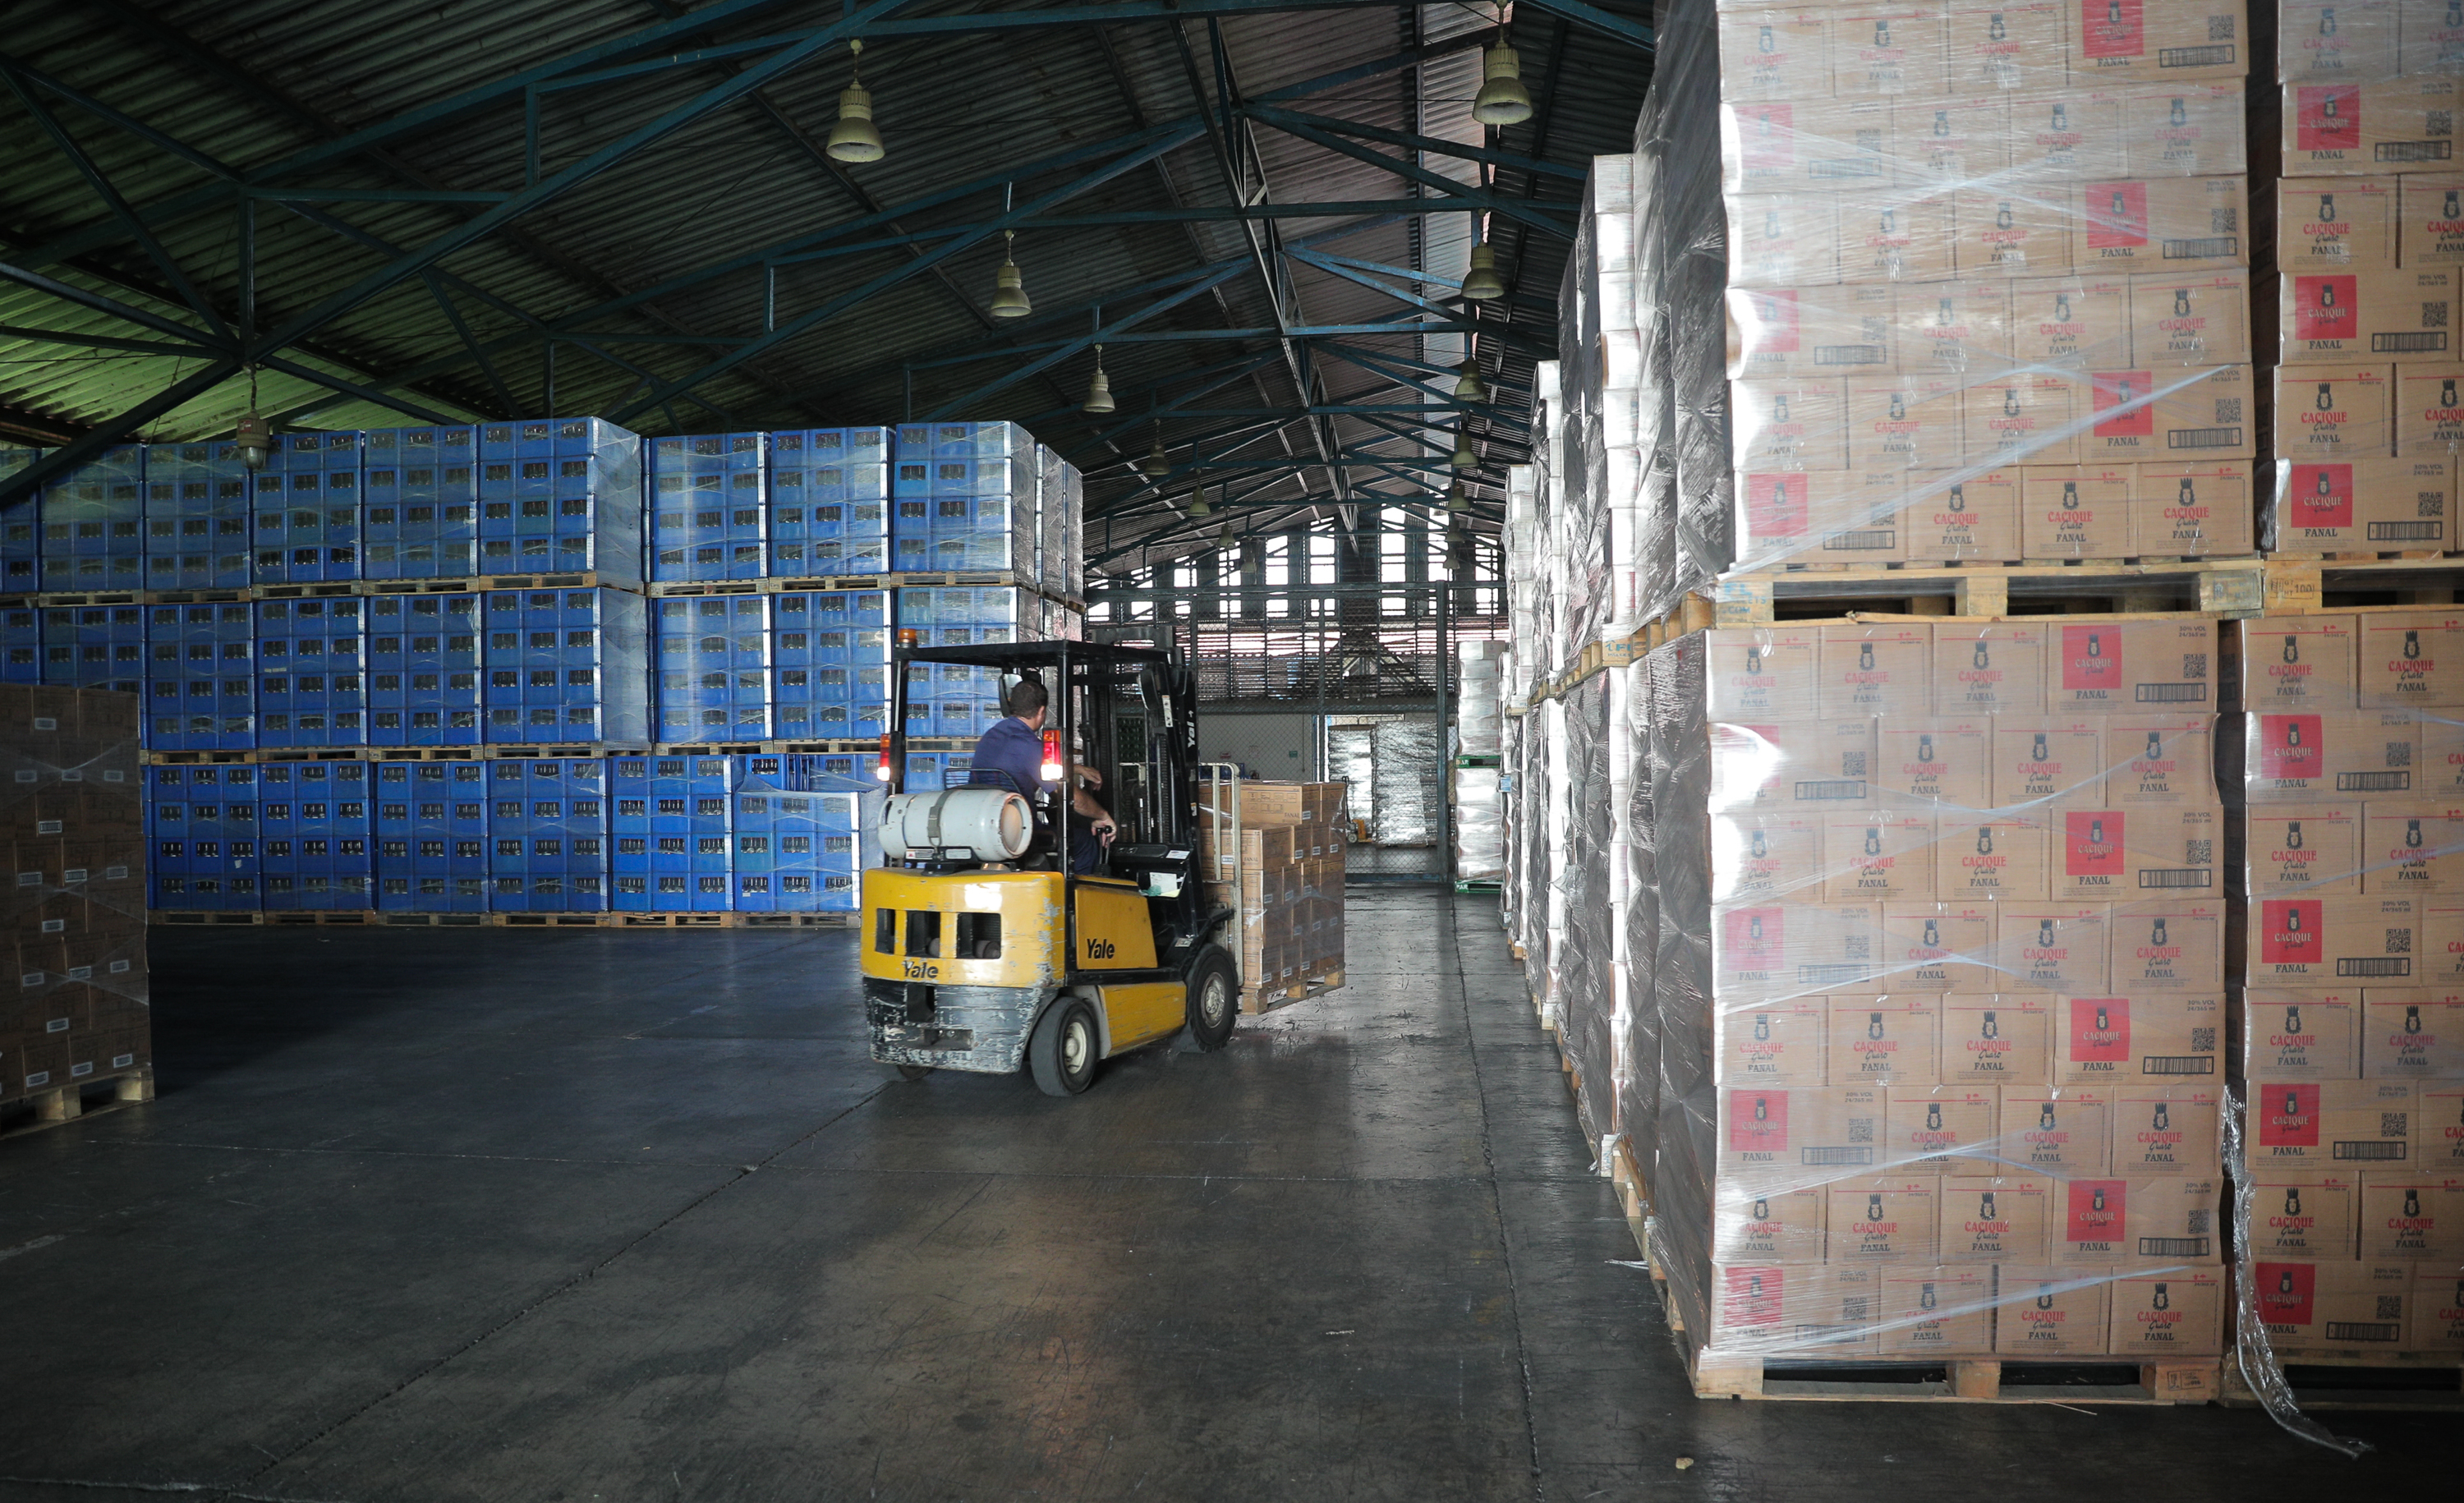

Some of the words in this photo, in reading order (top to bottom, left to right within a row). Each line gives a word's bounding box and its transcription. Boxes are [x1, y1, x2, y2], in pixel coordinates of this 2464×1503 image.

[2097, 57, 2130, 67] FANAL
[2311, 150, 2344, 160] FANAL
[2303, 223, 2350, 237] CACIQUE
[2427, 221, 2464, 235] CACIQU
[2102, 248, 2133, 257] FANAL
[2307, 308, 2347, 319] CACIQUE
[2159, 318, 2206, 332] CACIQUE
[2309, 340, 2342, 350] FANAL
[2301, 411, 2347, 425] CACIQUE
[2425, 408, 2464, 421] CACIQU
[2108, 437, 2139, 446] FANAL
[2309, 434, 2340, 442] FANAL
[2304, 497, 2342, 507] CACIQUE
[2048, 511, 2092, 523] CACIQUE
[2164, 507, 2209, 520] CACIQUE
[1934, 512, 1979, 526] CACIQUE
[2055, 533, 2086, 541] FANAL
[2172, 531, 2203, 539] FANAL
[2305, 528, 2337, 537] FANAL
[1942, 535, 1972, 544] FANAL
[2075, 659, 2112, 669] CACIQUE
[2388, 660, 2435, 673] CACIQUE
[2269, 664, 2312, 677] CACIQUE
[1845, 672, 1888, 684] CACIQUE
[1959, 670, 2002, 683] CACIQUE
[2396, 683, 2427, 691] FANAL
[1965, 692, 1996, 701] FANAL
[2076, 690, 2108, 699] FANAL
[2274, 747, 2313, 757] CACIQUE
[1904, 763, 1947, 775] CACIQUE
[2018, 762, 2062, 774] CACIQUE
[2131, 761, 2175, 773] CACIQUE
[2139, 784, 2169, 792] FANAL
[2274, 779, 2307, 788] FANAL
[1910, 785, 1941, 793] FANAL
[2025, 785, 2055, 793] FANAL
[2077, 844, 2115, 854] CACIQUE
[2272, 850, 2317, 863] CACIQUE
[1962, 856, 2006, 868] CACIQUE
[2279, 872, 2310, 880] FANAL
[2397, 871, 2429, 879] FANAL
[1857, 879, 1888, 887] FANAL
[1970, 878, 2000, 886] FANAL
[2079, 876, 2110, 885] FANAL
[2274, 933, 2312, 943] CACIQUE
[1087, 939, 1115, 959] Yale
[2137, 947, 2181, 959] CACIQUE
[2023, 949, 2068, 961] CACIQUE
[903, 960, 938, 978] Yale
[2145, 969, 2174, 977] FANAL
[2275, 964, 2307, 973] FANAL
[1916, 971, 1946, 979] FANAL
[2030, 971, 2060, 979] FANAL
[2083, 1032, 2121, 1041] CACIQUE
[2270, 1034, 2315, 1047] CACIQUE
[2389, 1034, 2436, 1048] CACIQUE
[1739, 1042, 1784, 1055] CACIQUE
[1854, 1041, 1897, 1053] CACIQUE
[1966, 1041, 2011, 1053] CACIQUE
[2277, 1057, 2308, 1065] FANAL
[2397, 1057, 2428, 1065] FANAL
[1747, 1064, 1777, 1072] FANAL
[1861, 1063, 1891, 1071] FANAL
[1974, 1062, 2004, 1070] FANAL
[2083, 1062, 2114, 1071] FANAL
[2272, 1116, 2310, 1126] CACIQUE
[2025, 1133, 2068, 1144] CACIQUE
[2137, 1132, 2182, 1144] CACIQUE
[2273, 1147, 2304, 1156] FANAL
[1742, 1152, 1773, 1161] FANAL
[2030, 1153, 2062, 1161] FANAL
[2145, 1154, 2174, 1162] FANAL
[2080, 1212, 2116, 1221] CACIQUE
[2270, 1216, 2314, 1229] CACIQUE
[2388, 1218, 2434, 1231] CACIQUE
[1853, 1223, 1896, 1234] CACIQUE
[1964, 1221, 2009, 1234] CACIQUE
[1745, 1243, 1775, 1251] FANAL
[1860, 1243, 1890, 1252] FANAL
[1971, 1243, 2002, 1251] FANAL
[2080, 1243, 2110, 1252] FANAL
[2276, 1239, 2306, 1247] FANAL
[2395, 1239, 2426, 1248] FANAL
[2020, 1311, 2066, 1323] CACIQUE
[2138, 1311, 2181, 1323] CACIQUE
[1913, 1332, 1942, 1340] FANAL
[2028, 1331, 2058, 1340] FANAL
[2144, 1332, 2174, 1340] FANAL
